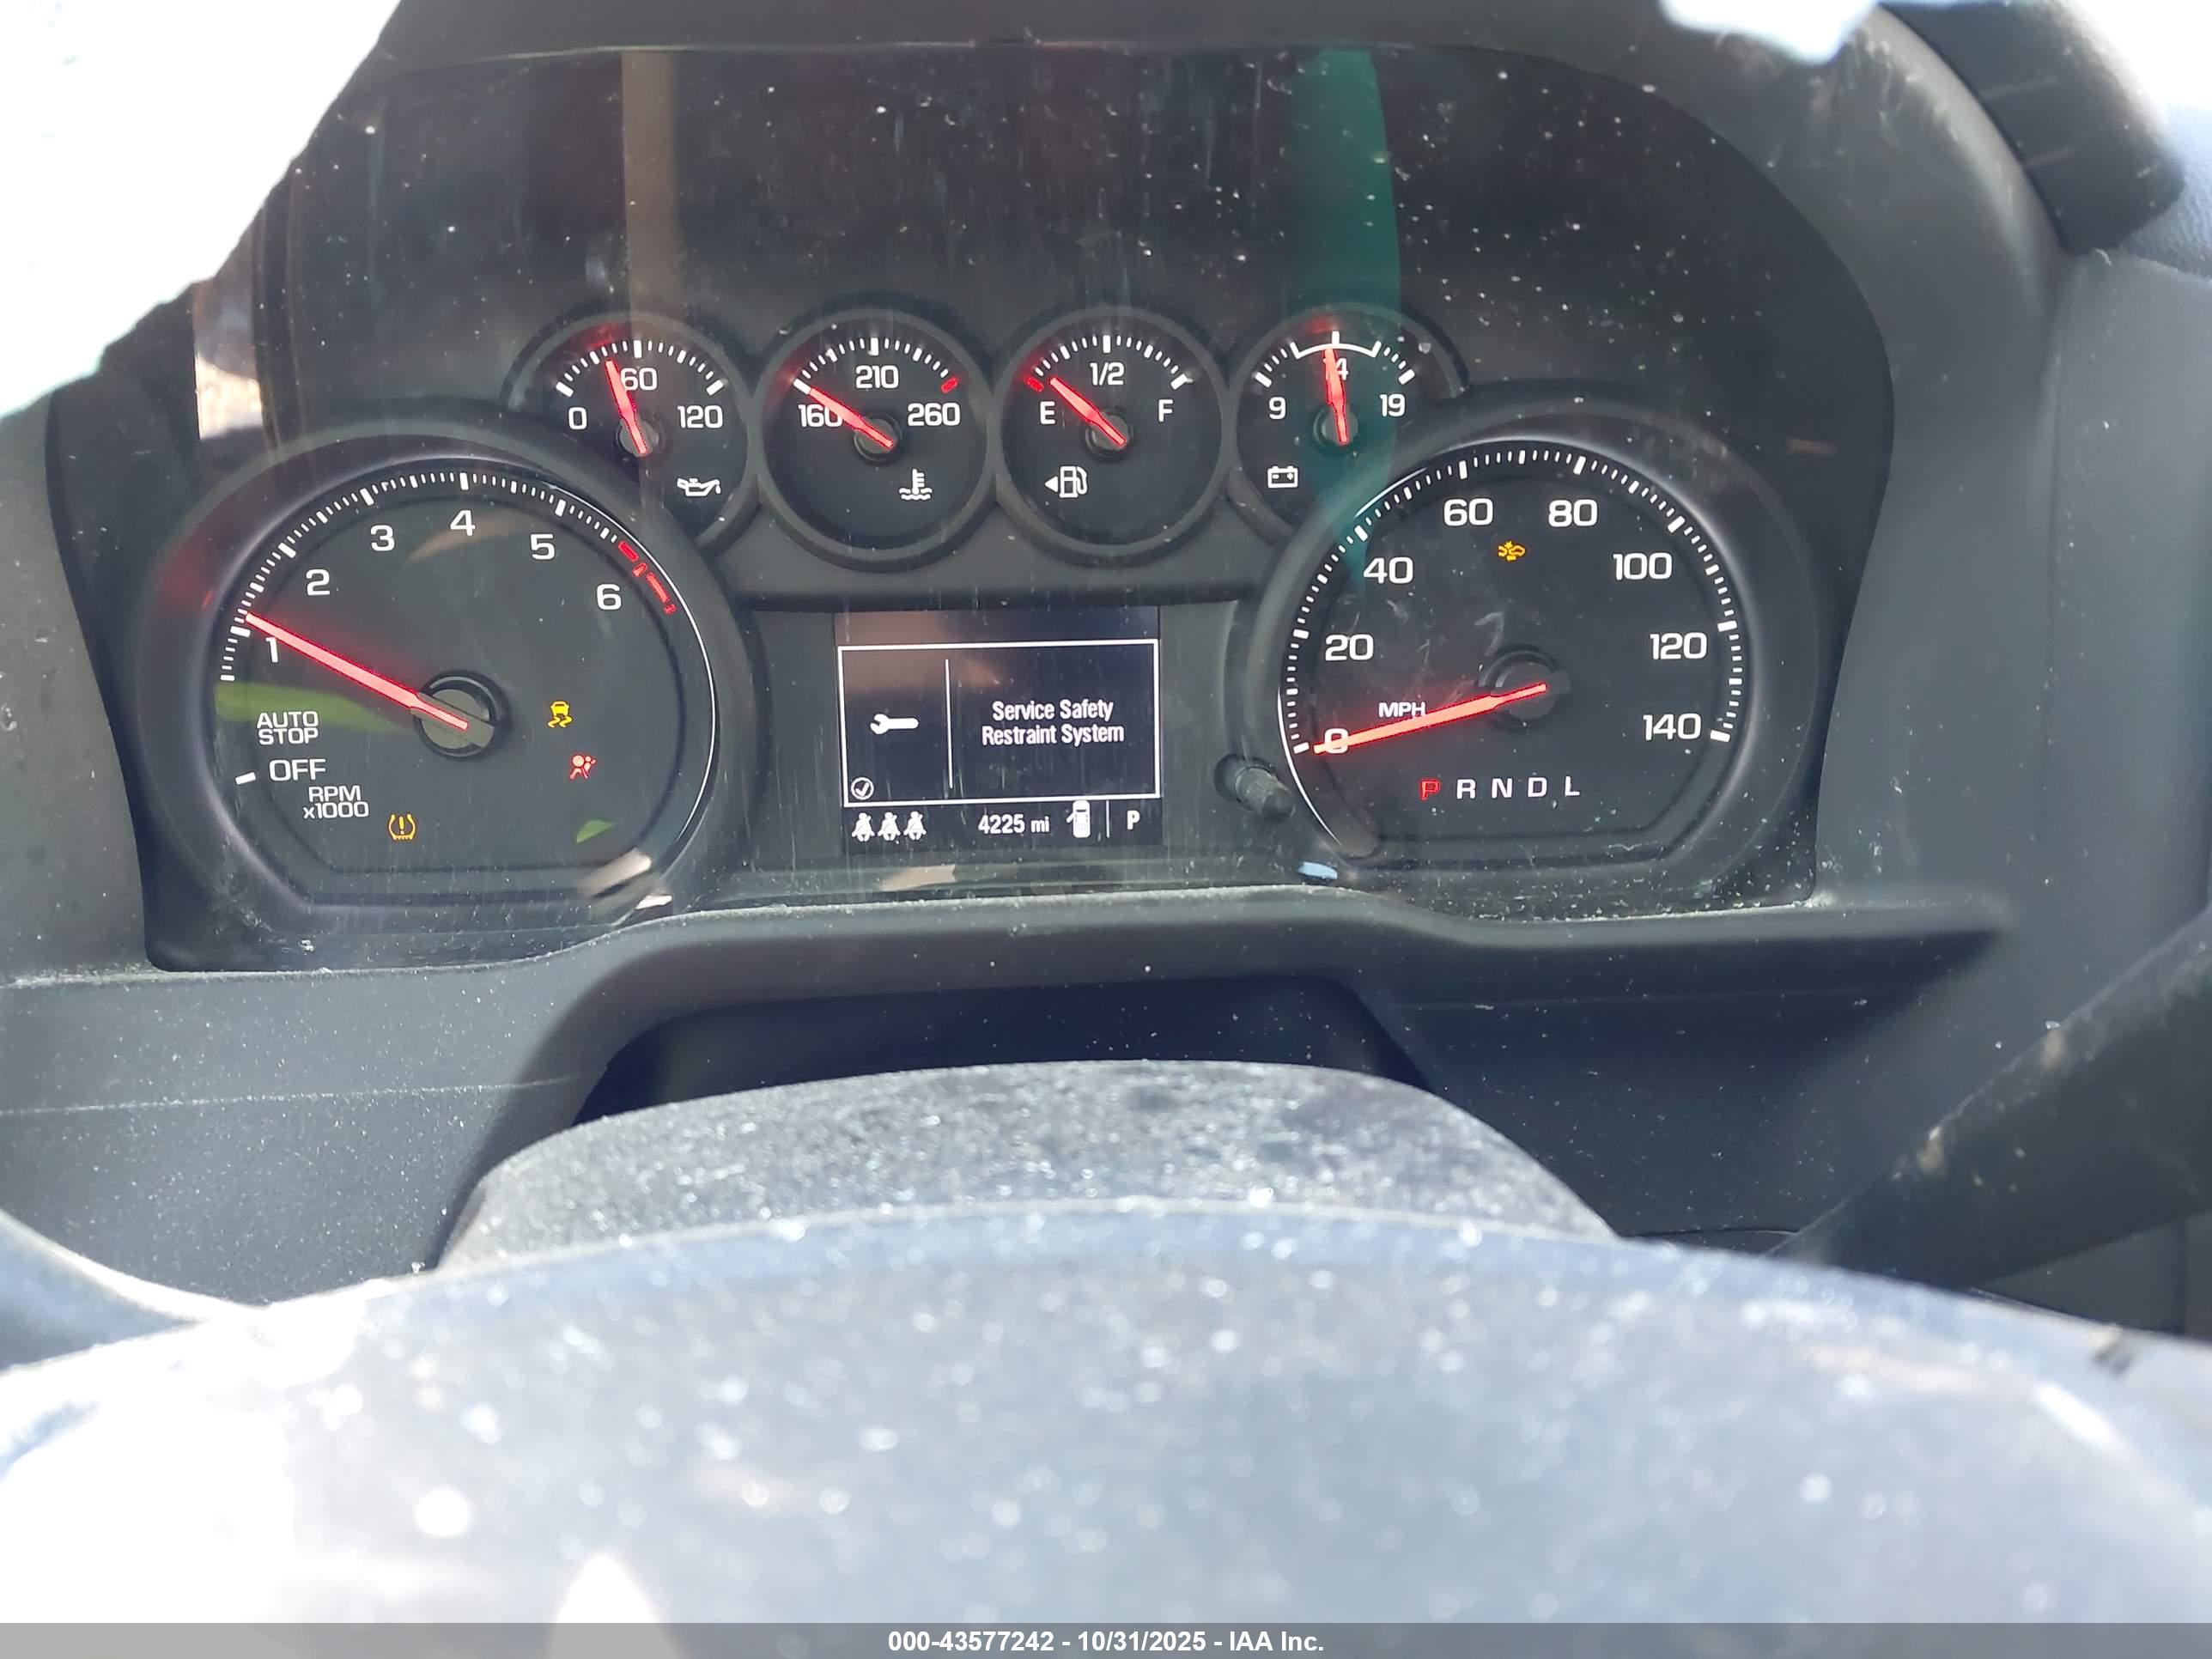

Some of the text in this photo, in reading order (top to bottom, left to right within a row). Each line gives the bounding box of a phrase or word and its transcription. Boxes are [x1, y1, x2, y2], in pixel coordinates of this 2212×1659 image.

[620, 368, 657, 391] 60
[855, 365, 898, 388] 210
[1090, 362, 1124, 386] 1/2
[798, 404, 843, 428] 160
[908, 404, 960, 426] 260
[1040, 402, 1055, 425] E
[1158, 400, 1173, 422] F
[1269, 398, 1286, 420] 9
[1380, 393, 1406, 416] 19
[568, 406, 587, 429] 0
[678, 405, 723, 428] 120
[450, 510, 475, 536] 4
[1443, 498, 1493, 526] 60
[1548, 499, 1598, 527] 80
[371, 526, 394, 551] 3
[530, 533, 555, 560] 5
[1364, 556, 1414, 584] 40
[1613, 552, 1672, 580] 100
[306, 569, 331, 596] 2
[596, 584, 622, 611] 6
[1325, 634, 1374, 660] 20
[1650, 632, 1708, 660] 120
[257, 711, 319, 728] AUTO
[992, 699, 1114, 722] Service Safety
[1377, 702, 1426, 718] MPH
[258, 728, 319, 745] STOP
[981, 724, 1125, 747] Restraint System
[1643, 714, 1702, 740] 140
[1323, 728, 1350, 754] 0
[269, 759, 326, 781] OFF
[307, 786, 362, 802] RPM
[1420, 776, 1580, 799] P R N D L
[302, 800, 369, 819] x1000
[1127, 811, 1140, 830] P
[978, 814, 1050, 835] 4225 mi
